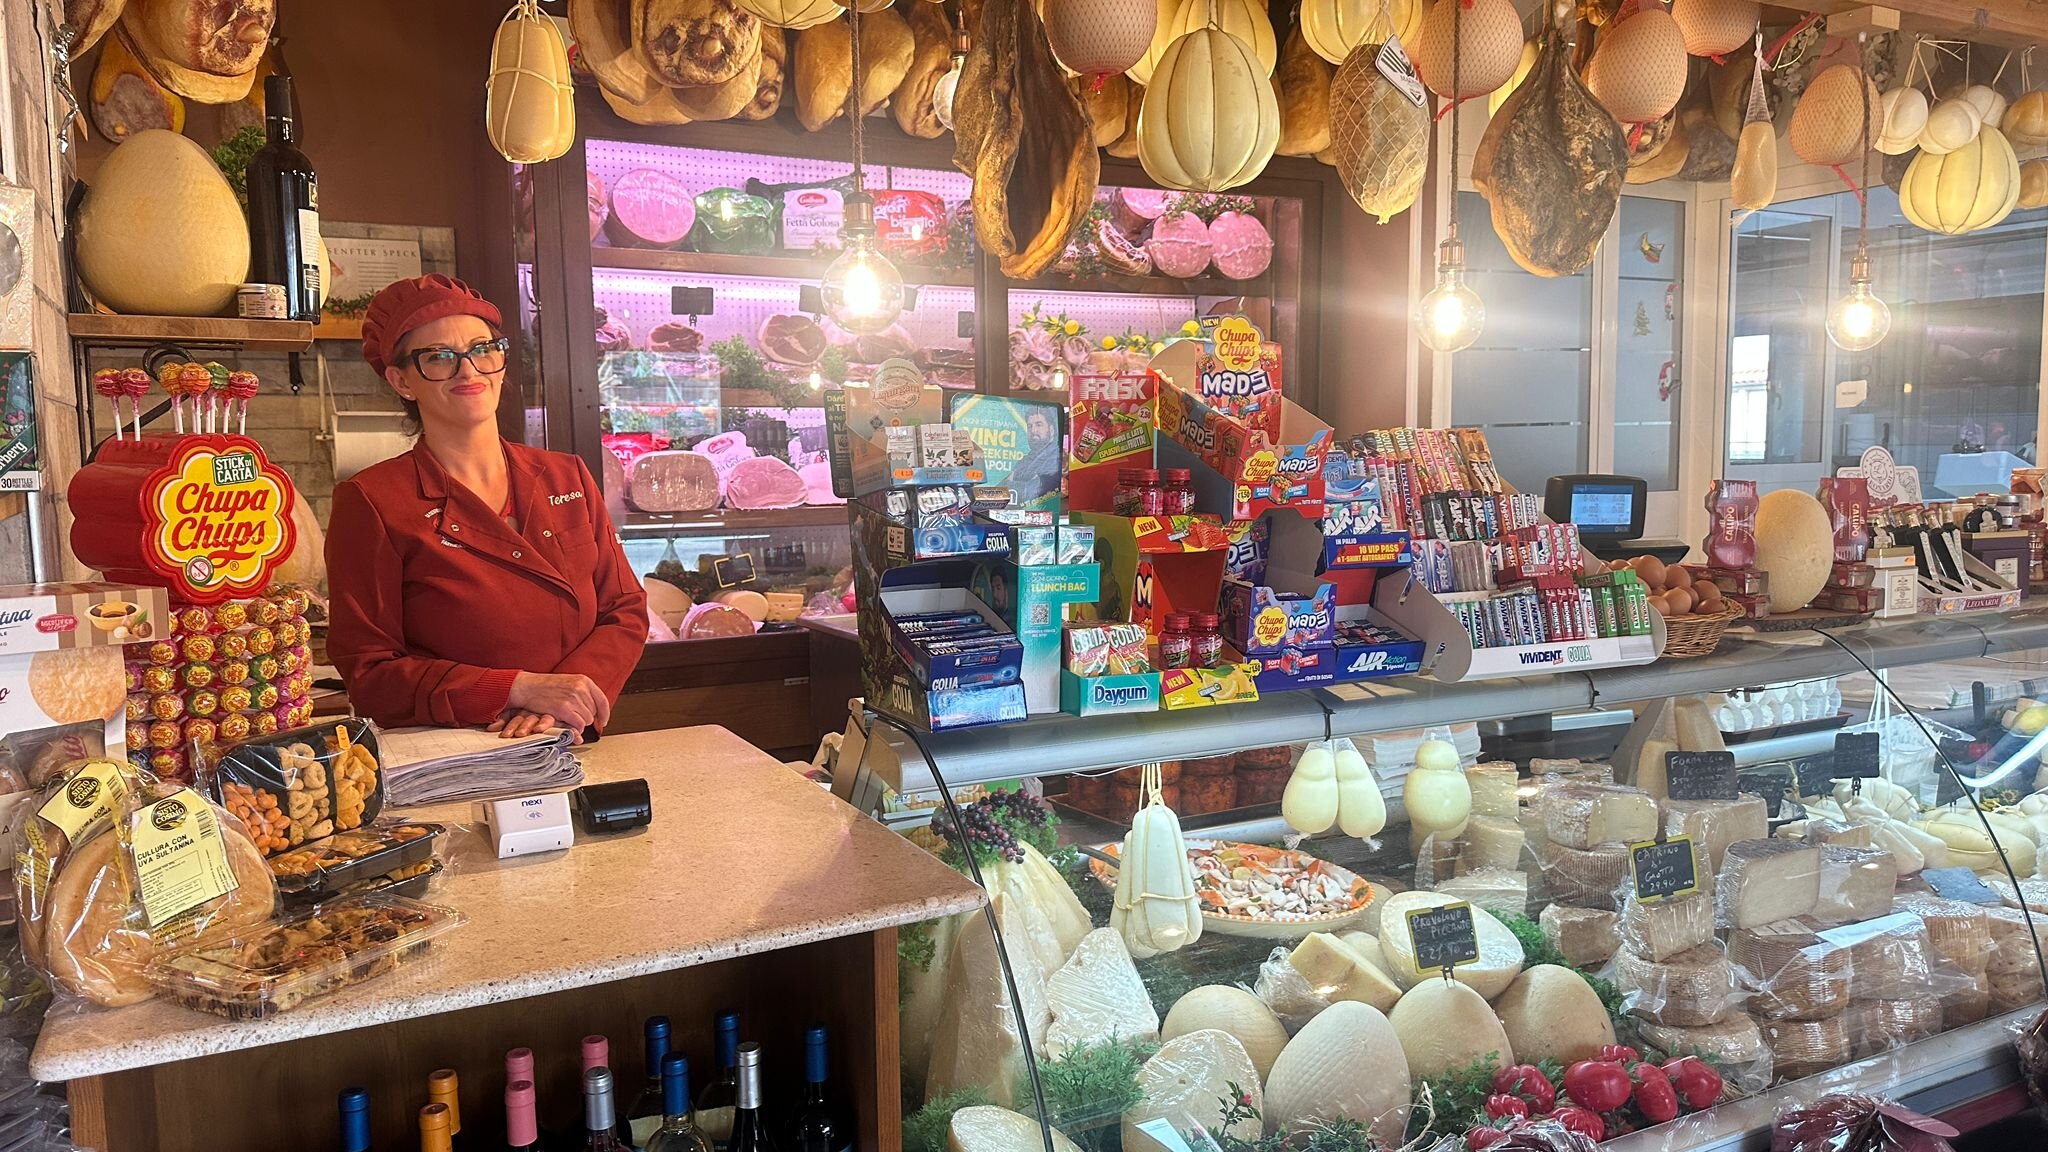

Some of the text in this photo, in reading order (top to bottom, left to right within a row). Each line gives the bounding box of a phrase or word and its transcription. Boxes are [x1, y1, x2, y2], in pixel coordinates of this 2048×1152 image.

[786, 217, 840, 228] Fetta Golosa
[383, 248, 418, 258] SPECK
[1202, 318, 1219, 328] NEW
[1220, 329, 1256, 345] Chupa
[1219, 342, 1256, 365] Chups
[964, 426, 1017, 448] VINCI
[215, 456, 245, 471] STICK
[1250, 458, 1275, 469] Chupa
[217, 467, 253, 483] CARTA
[1, 478, 12, 489] 30
[176, 483, 270, 521] Chupa
[548, 490, 583, 507] Teresa
[1137, 520, 1157, 534] NEW
[171, 515, 266, 564] Chups
[1359, 544, 1399, 554] 10 VIP PASS
[1068, 582, 1086, 591] BAG
[1966, 598, 1999, 608] LEONARDI
[1260, 616, 1284, 626] Chupa
[1258, 625, 1282, 639] Chups
[1348, 651, 1387, 672] AIR
[1165, 675, 1186, 690] NEW
[1094, 685, 1148, 706] Daygum
[72, 780, 90, 797] SISTO
[73, 780, 98, 804] COSIMO
[156, 803, 179, 817] SISTO
[521, 798, 542, 807] nexi
[155, 808, 187, 825] COSIMO
[137, 833, 188, 861] CULLURA CON
[138, 838, 195, 868] UVA SULTANINA
